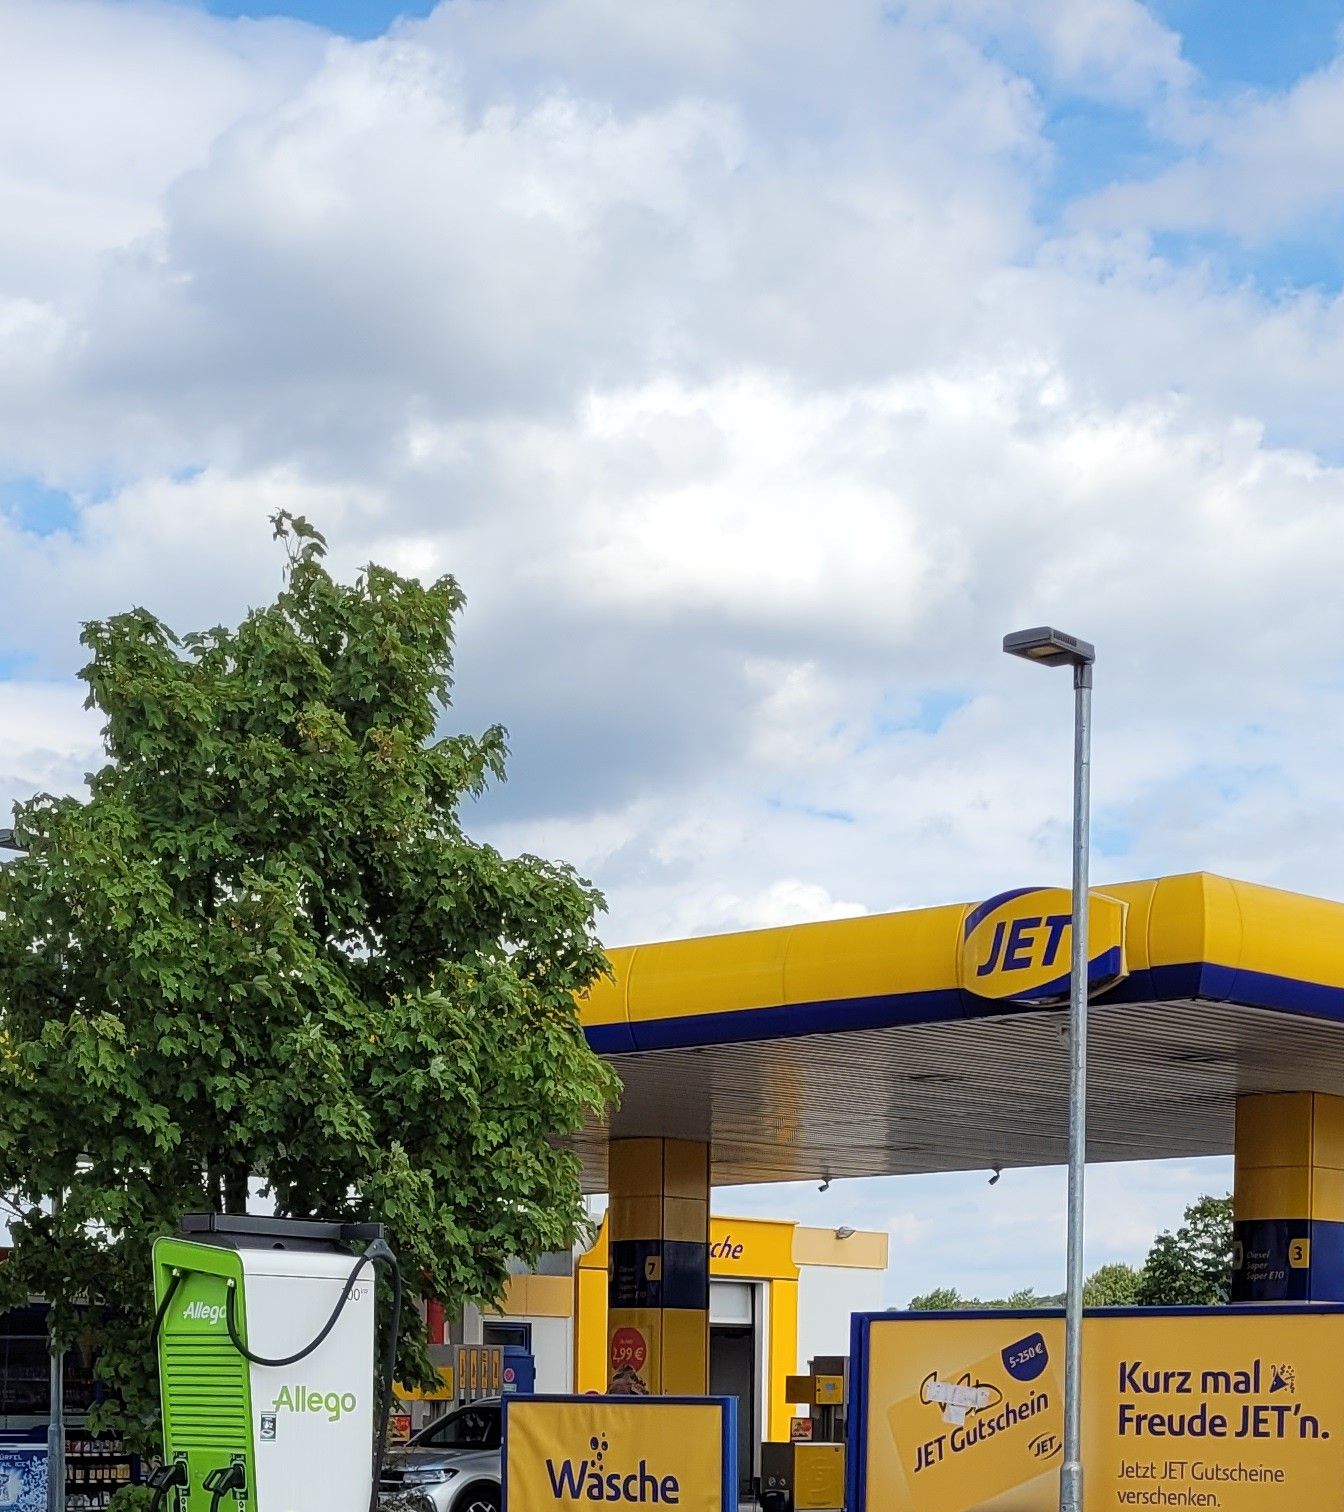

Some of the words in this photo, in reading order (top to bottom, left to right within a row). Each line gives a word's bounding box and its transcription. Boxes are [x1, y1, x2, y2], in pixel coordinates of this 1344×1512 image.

[976, 914, 1072, 977] JET
[1246, 1249, 1271, 1259] Diesel
[1293, 1245, 1303, 1261] 3
[647, 1262, 656, 1276] 7
[1246, 1272, 1268, 1281] Super
[1268, 1271, 1285, 1280] E10
[1119, 1360, 1192, 1394] Kurz
[1201, 1358, 1261, 1394] mal
[272, 1385, 357, 1422] Allego
[914, 1434, 947, 1473] JET
[950, 1390, 1049, 1453] Gutschein
[1118, 1402, 1228, 1437] Freude
[1234, 1403, 1331, 1440] JET'n.
[1033, 1436, 1057, 1458] JET
[545, 1458, 680, 1505] Wäsche
[1117, 1460, 1157, 1479] Jetzt
[1160, 1461, 1188, 1480] JET
[1191, 1461, 1285, 1483] Gutscheine
[1117, 1486, 1222, 1507] verschenken.
